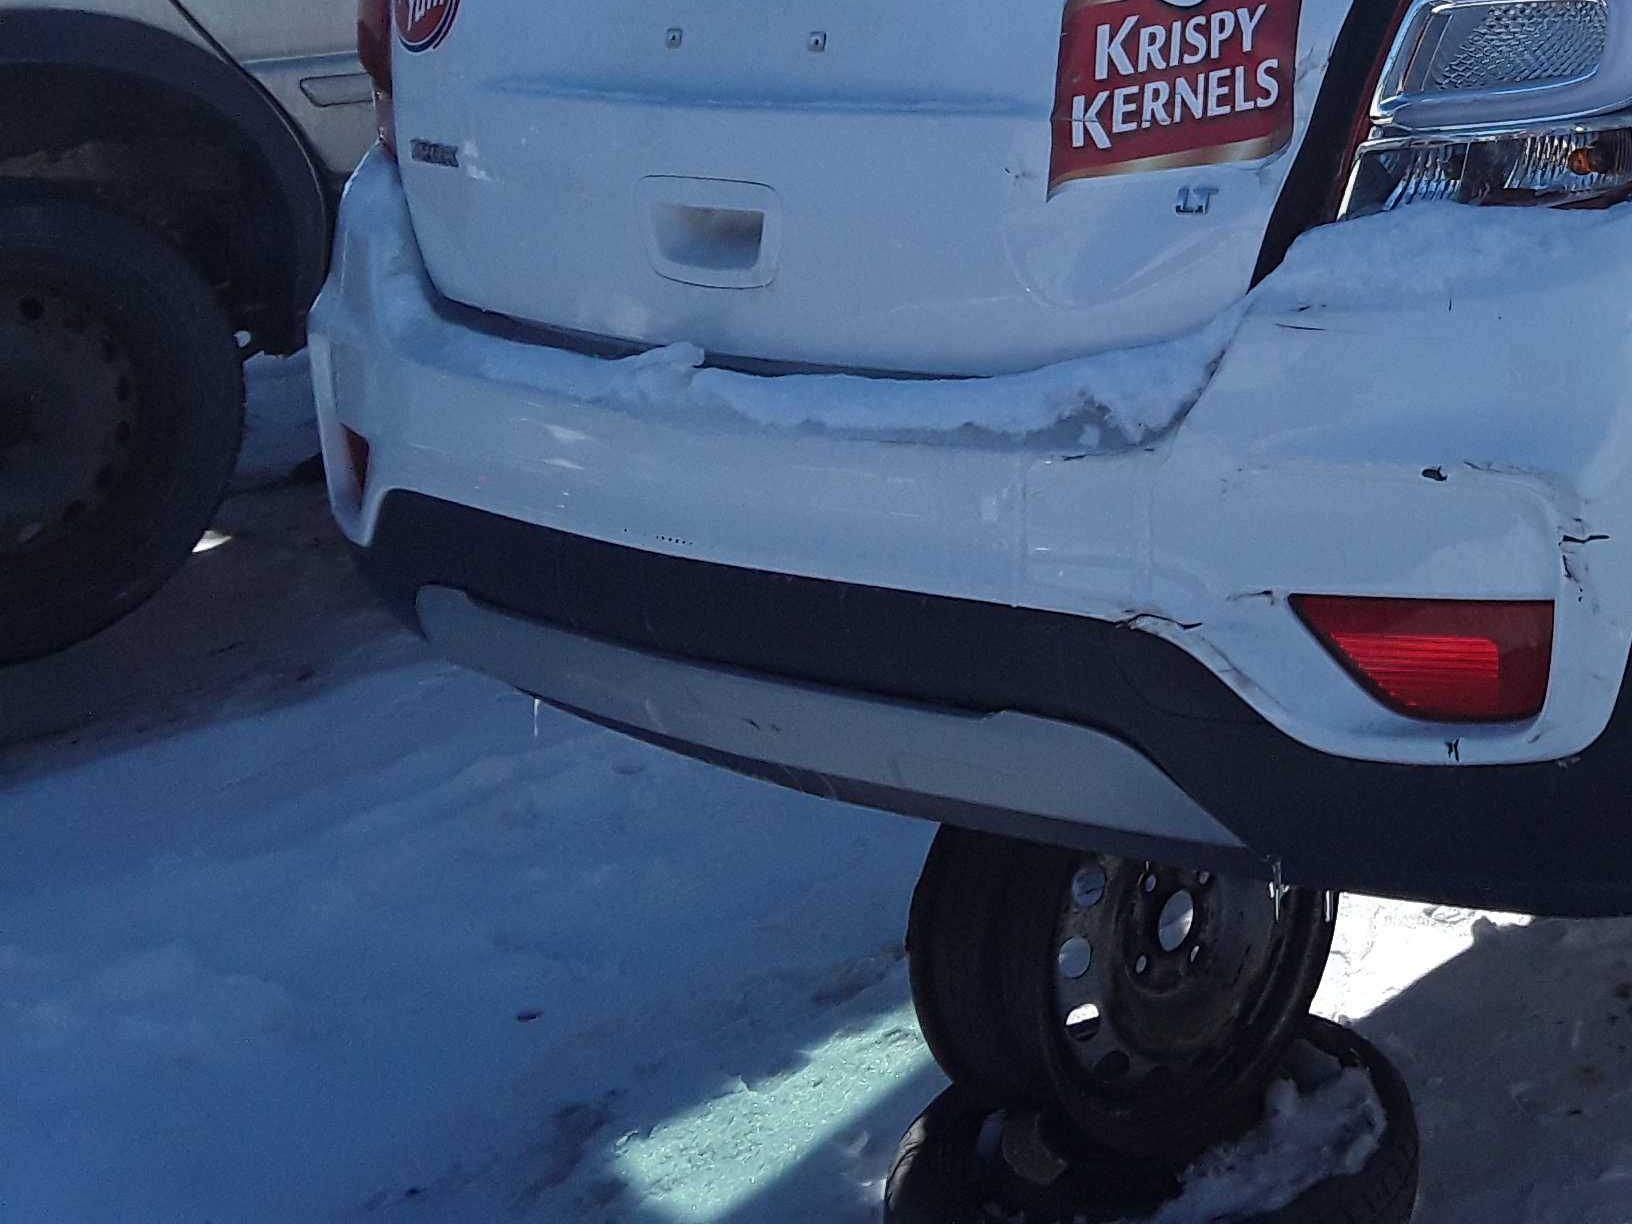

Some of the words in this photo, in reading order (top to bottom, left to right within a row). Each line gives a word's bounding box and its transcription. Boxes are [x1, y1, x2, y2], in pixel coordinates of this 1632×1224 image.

[1094, 4, 1269, 80] KRISPY
[1071, 59, 1280, 149] KERNELS
[1175, 185, 1219, 216] LT
